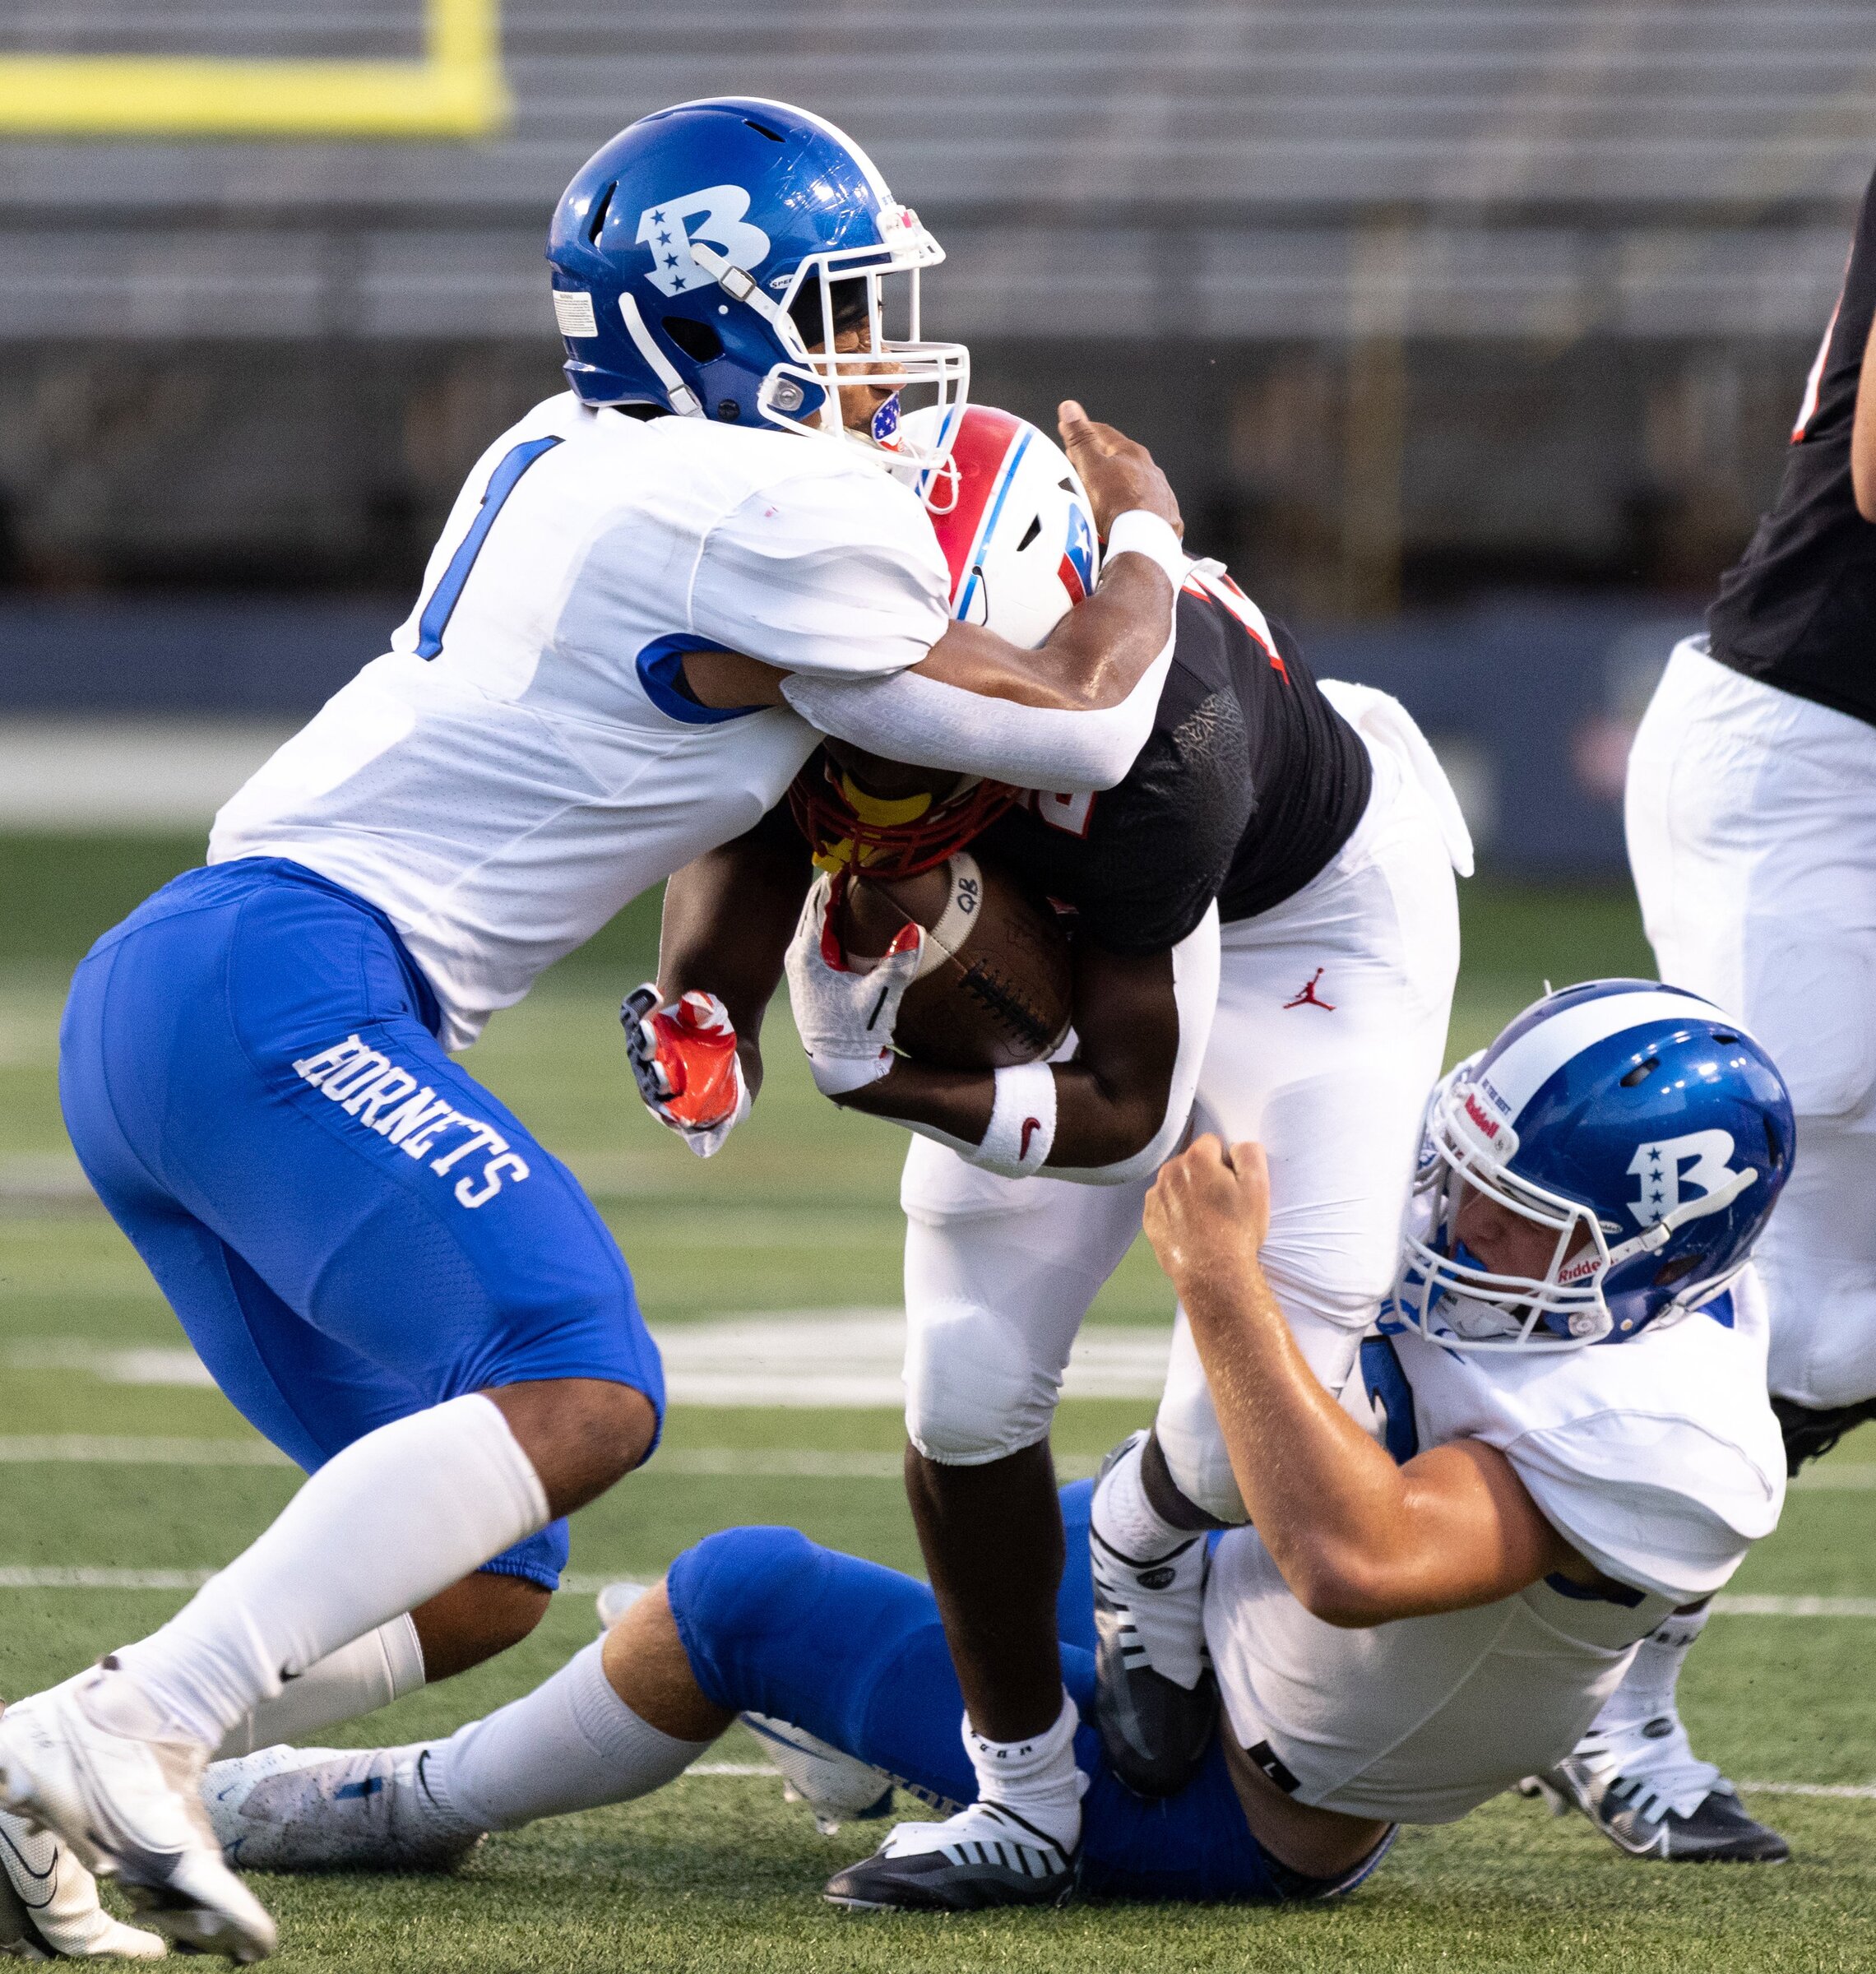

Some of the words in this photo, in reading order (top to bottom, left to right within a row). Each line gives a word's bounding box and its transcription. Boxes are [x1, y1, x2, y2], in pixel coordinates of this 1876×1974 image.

[636, 184, 771, 298] B
[412, 435, 567, 661] 1
[957, 878, 978, 915] QB
[292, 1034, 530, 1208] HORNETS
[1626, 1128, 1738, 1229] B
[1558, 1257, 1614, 1283] Ridde
